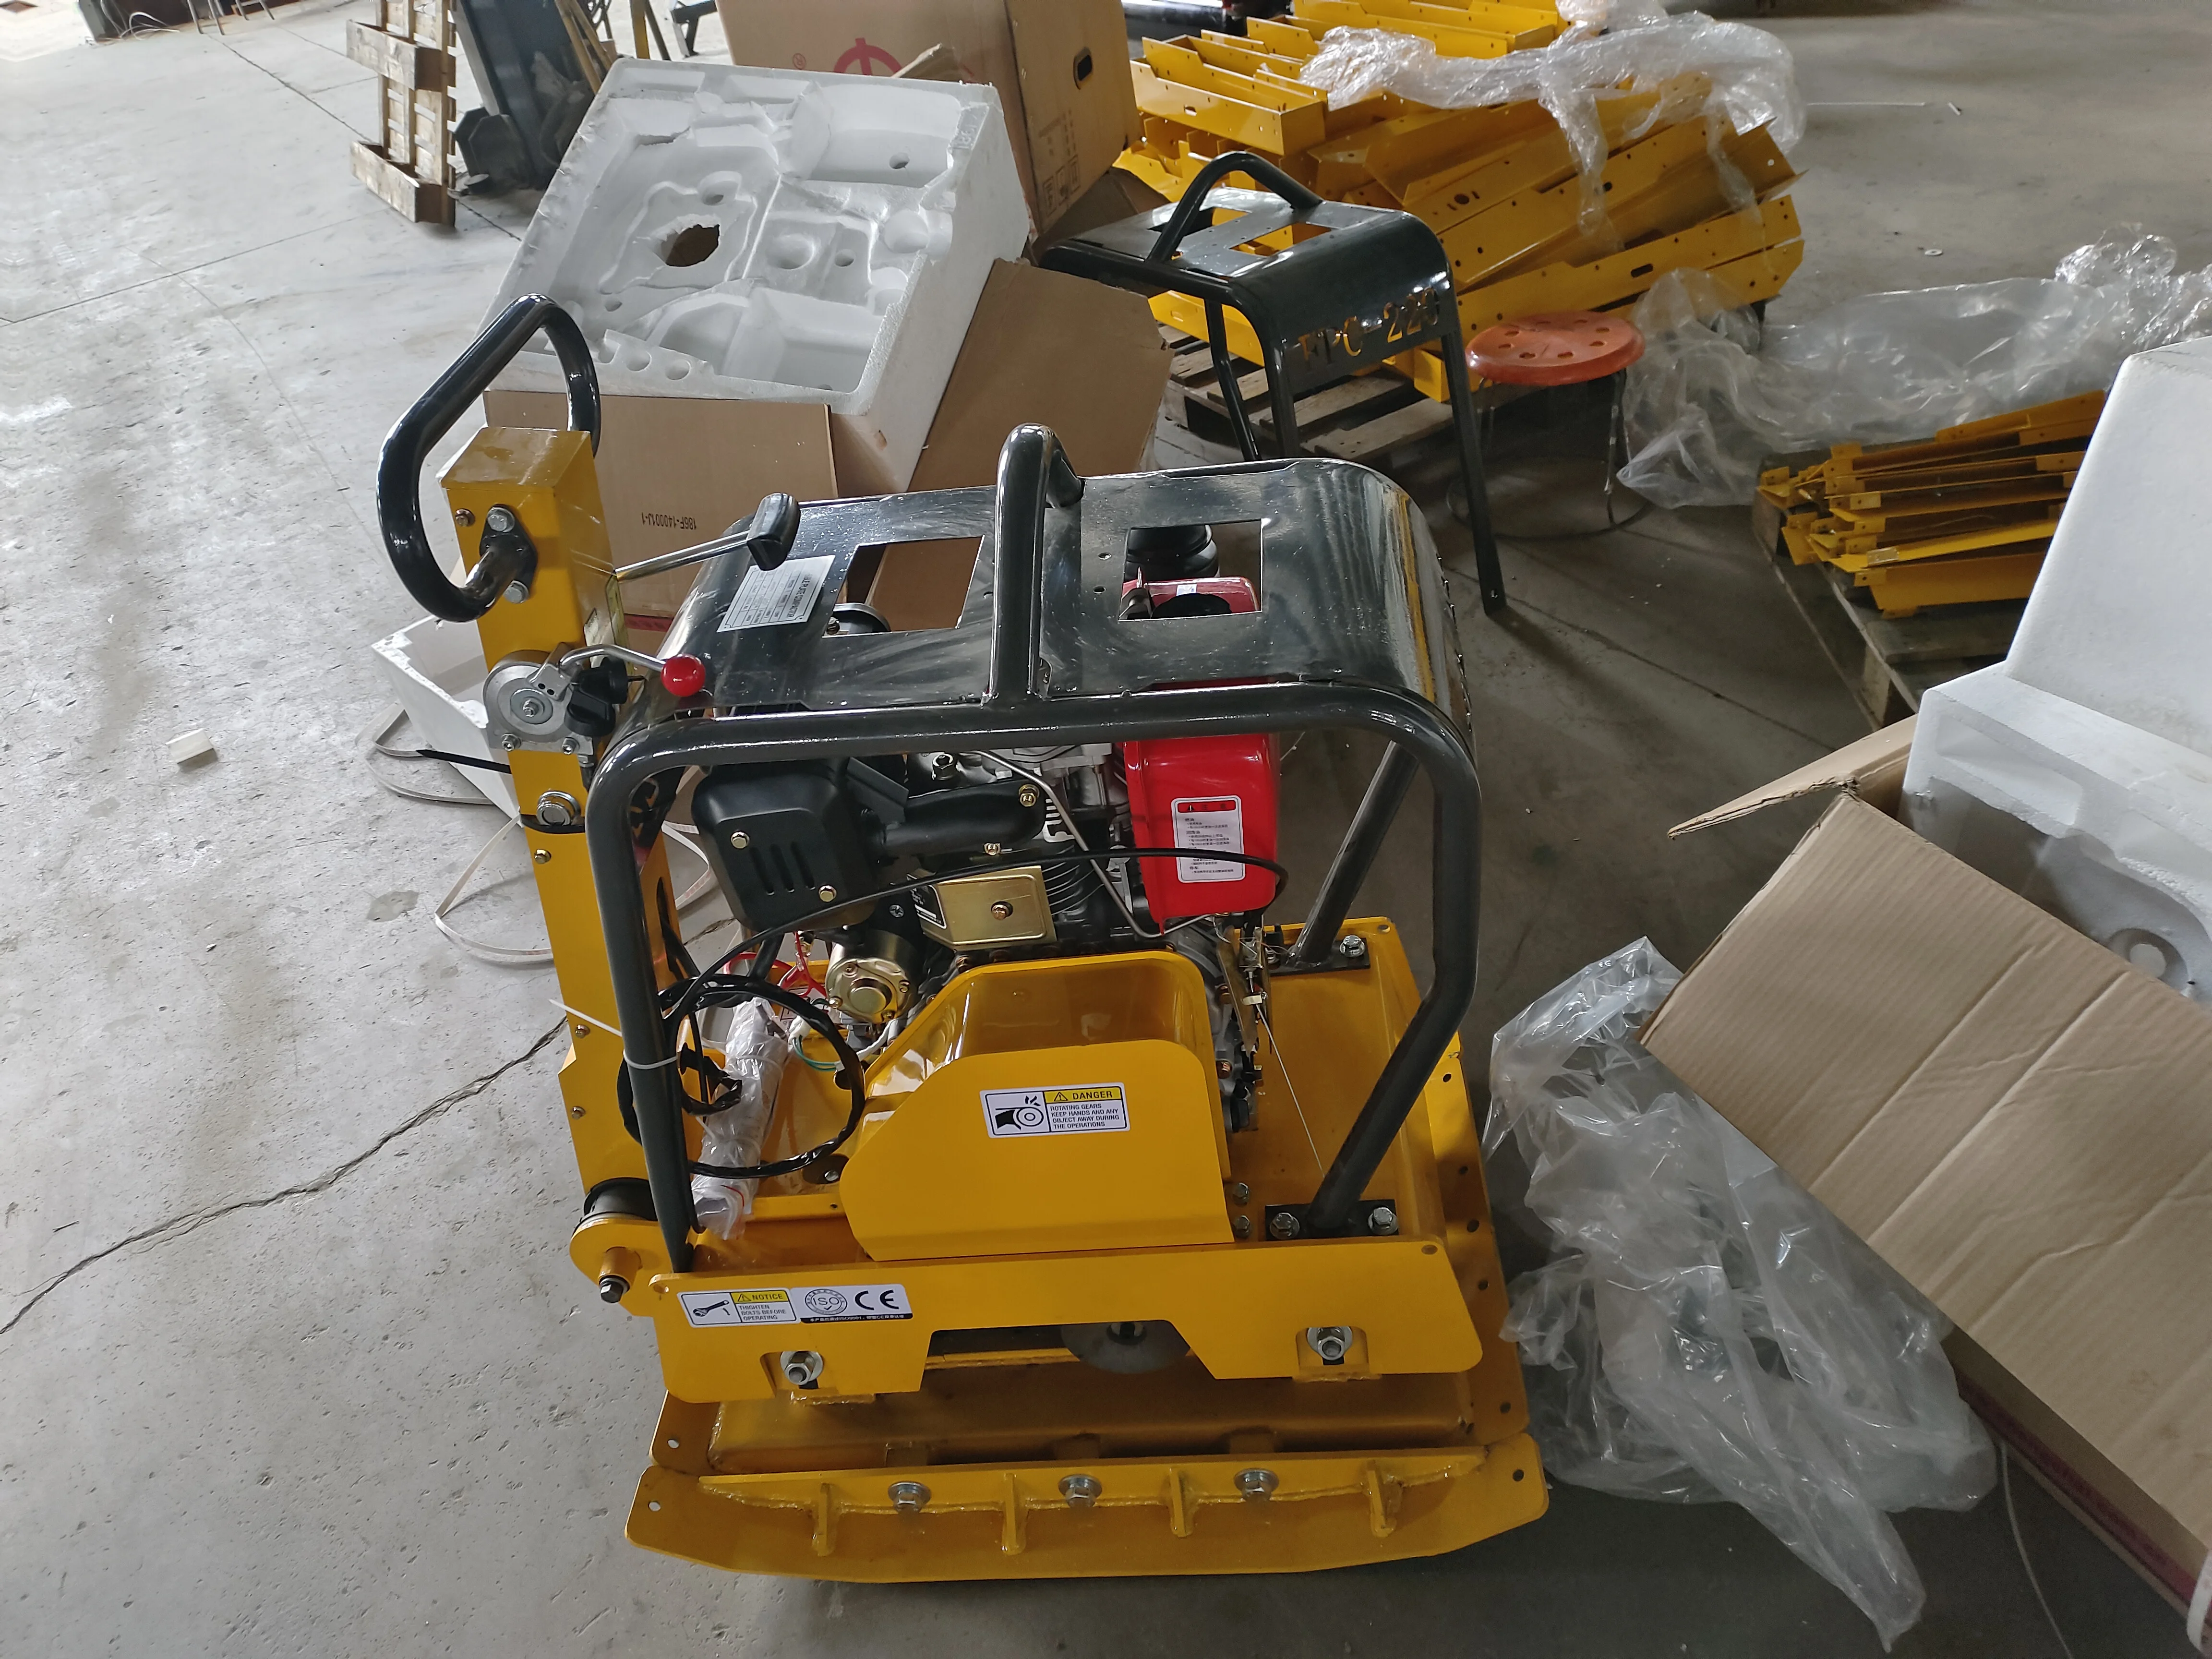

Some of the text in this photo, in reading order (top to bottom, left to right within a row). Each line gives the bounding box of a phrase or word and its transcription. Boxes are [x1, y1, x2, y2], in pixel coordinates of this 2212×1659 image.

[1072, 1091, 1113, 1100] DANGER
[813, 1297, 840, 1306] ISO
[854, 1289, 900, 1310] CE
